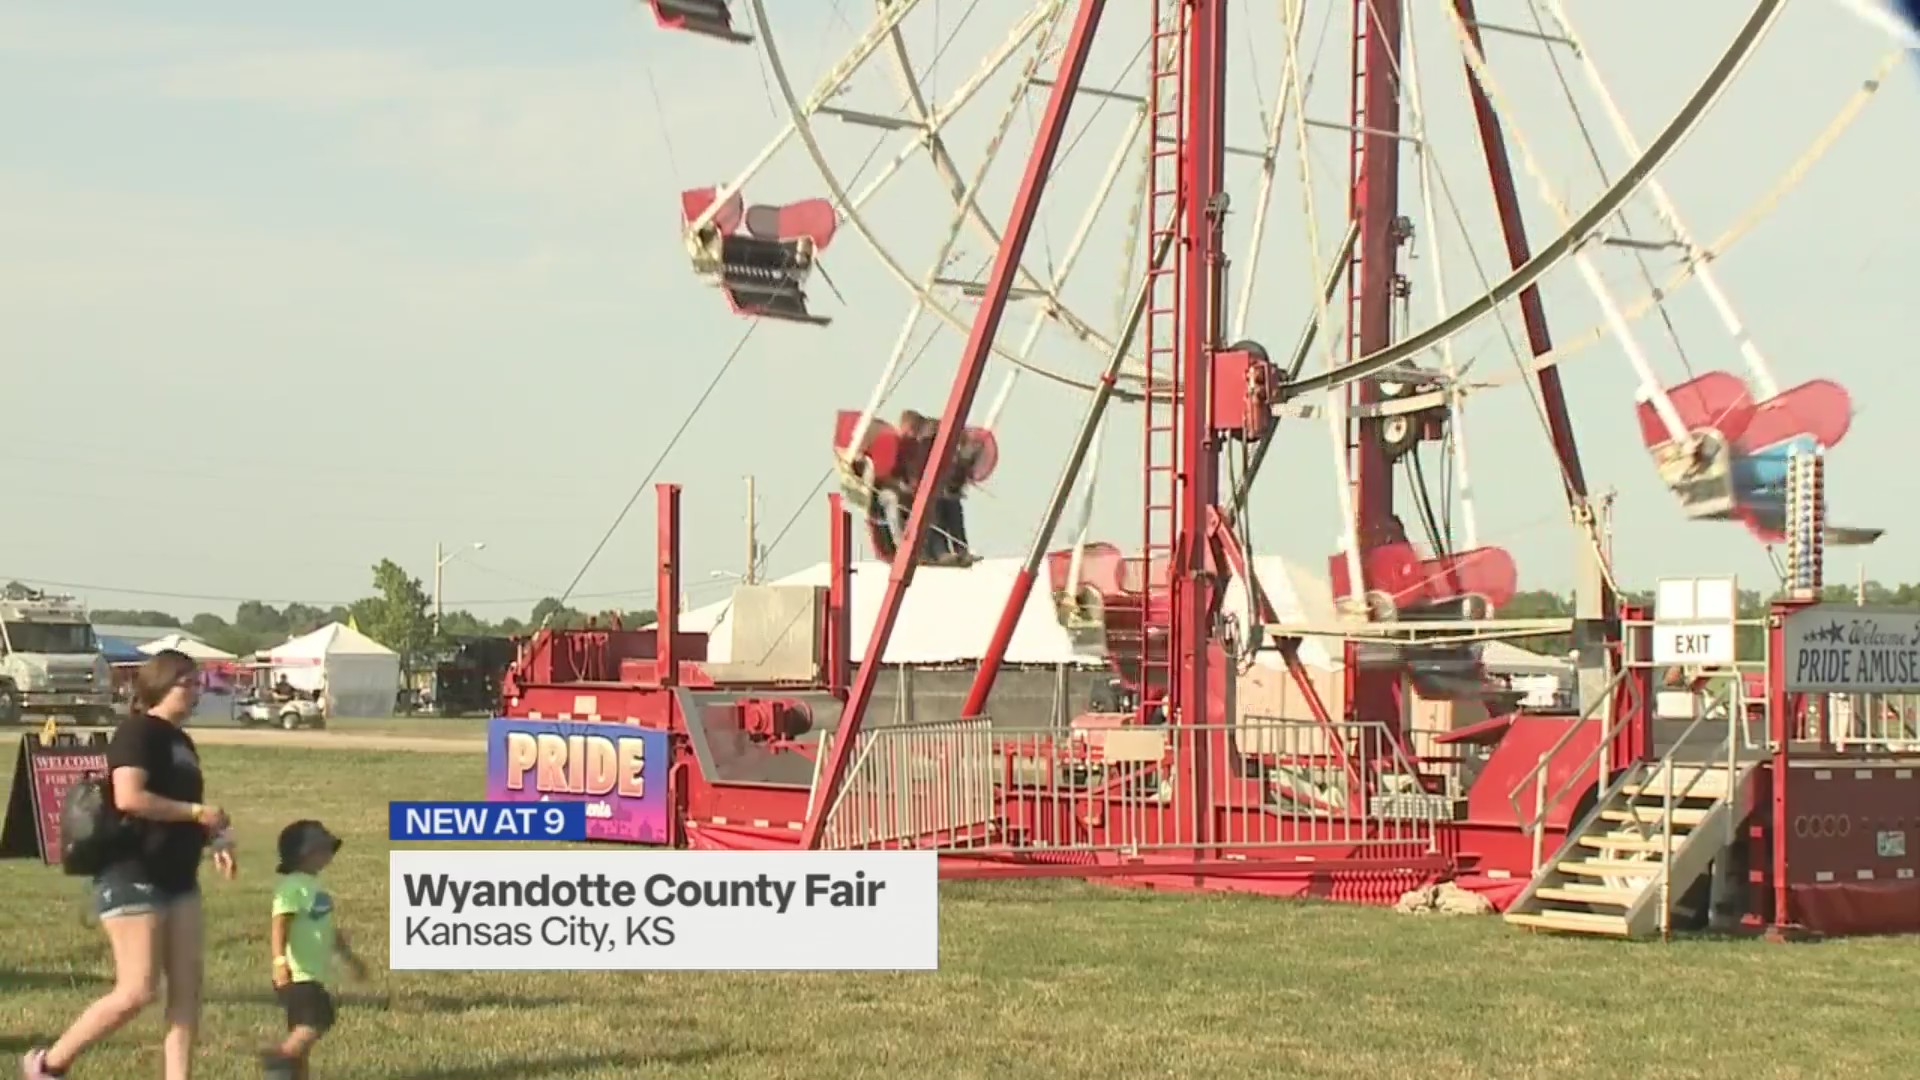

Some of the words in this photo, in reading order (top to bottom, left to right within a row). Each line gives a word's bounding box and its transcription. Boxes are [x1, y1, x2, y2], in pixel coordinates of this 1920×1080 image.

[1675, 634, 1711, 654] EXIT
[1848, 618, 1906, 645] Welcome
[1797, 648, 1852, 682] PRIDE
[1856, 648, 1920, 683] AMUSE
[507, 730, 645, 799] PRIDE
